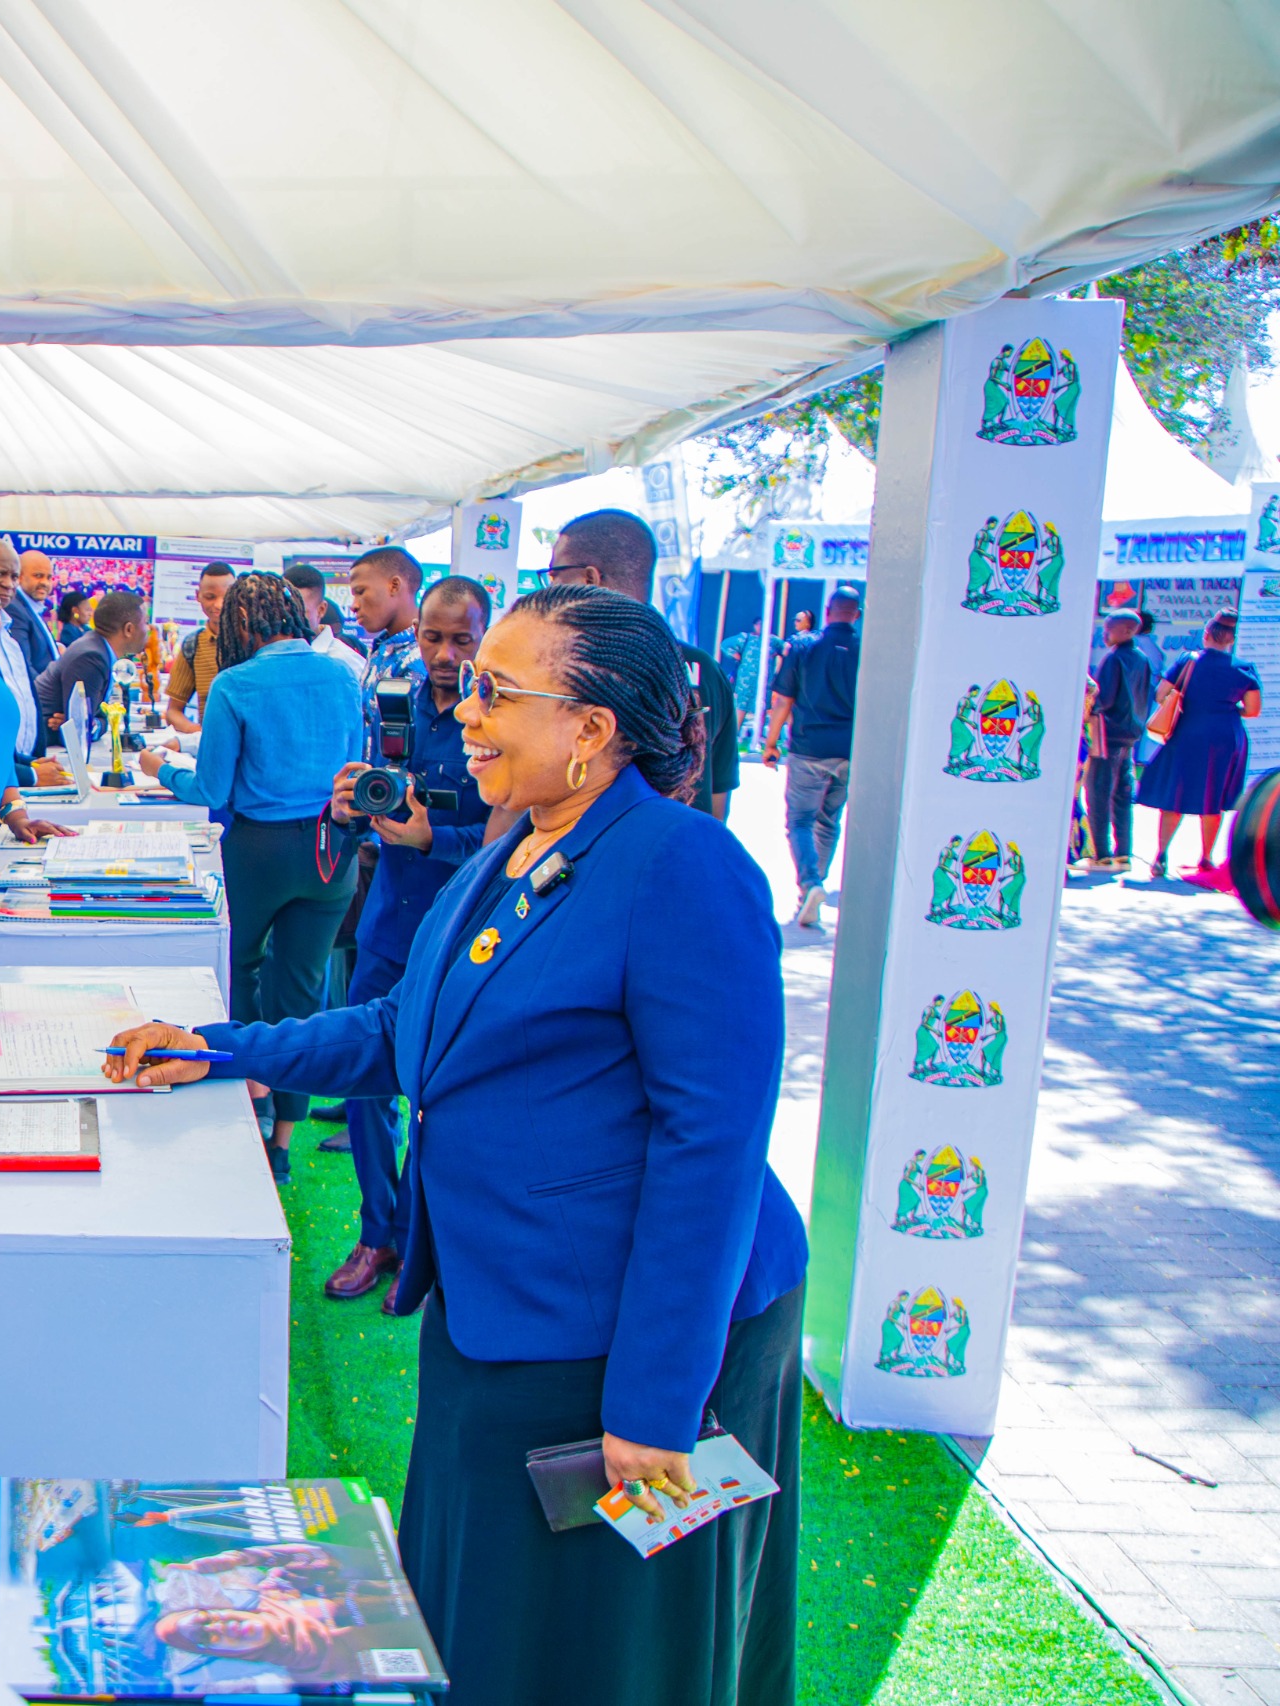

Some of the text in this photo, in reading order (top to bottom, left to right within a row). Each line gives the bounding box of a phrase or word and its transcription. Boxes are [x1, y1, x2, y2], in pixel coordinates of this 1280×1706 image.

[18, 533, 70, 549] TUKO
[75, 535, 143, 551] TAYARI
[239, 1486, 277, 1540] MIAKA
[265, 1485, 305, 1540] MIWILI
